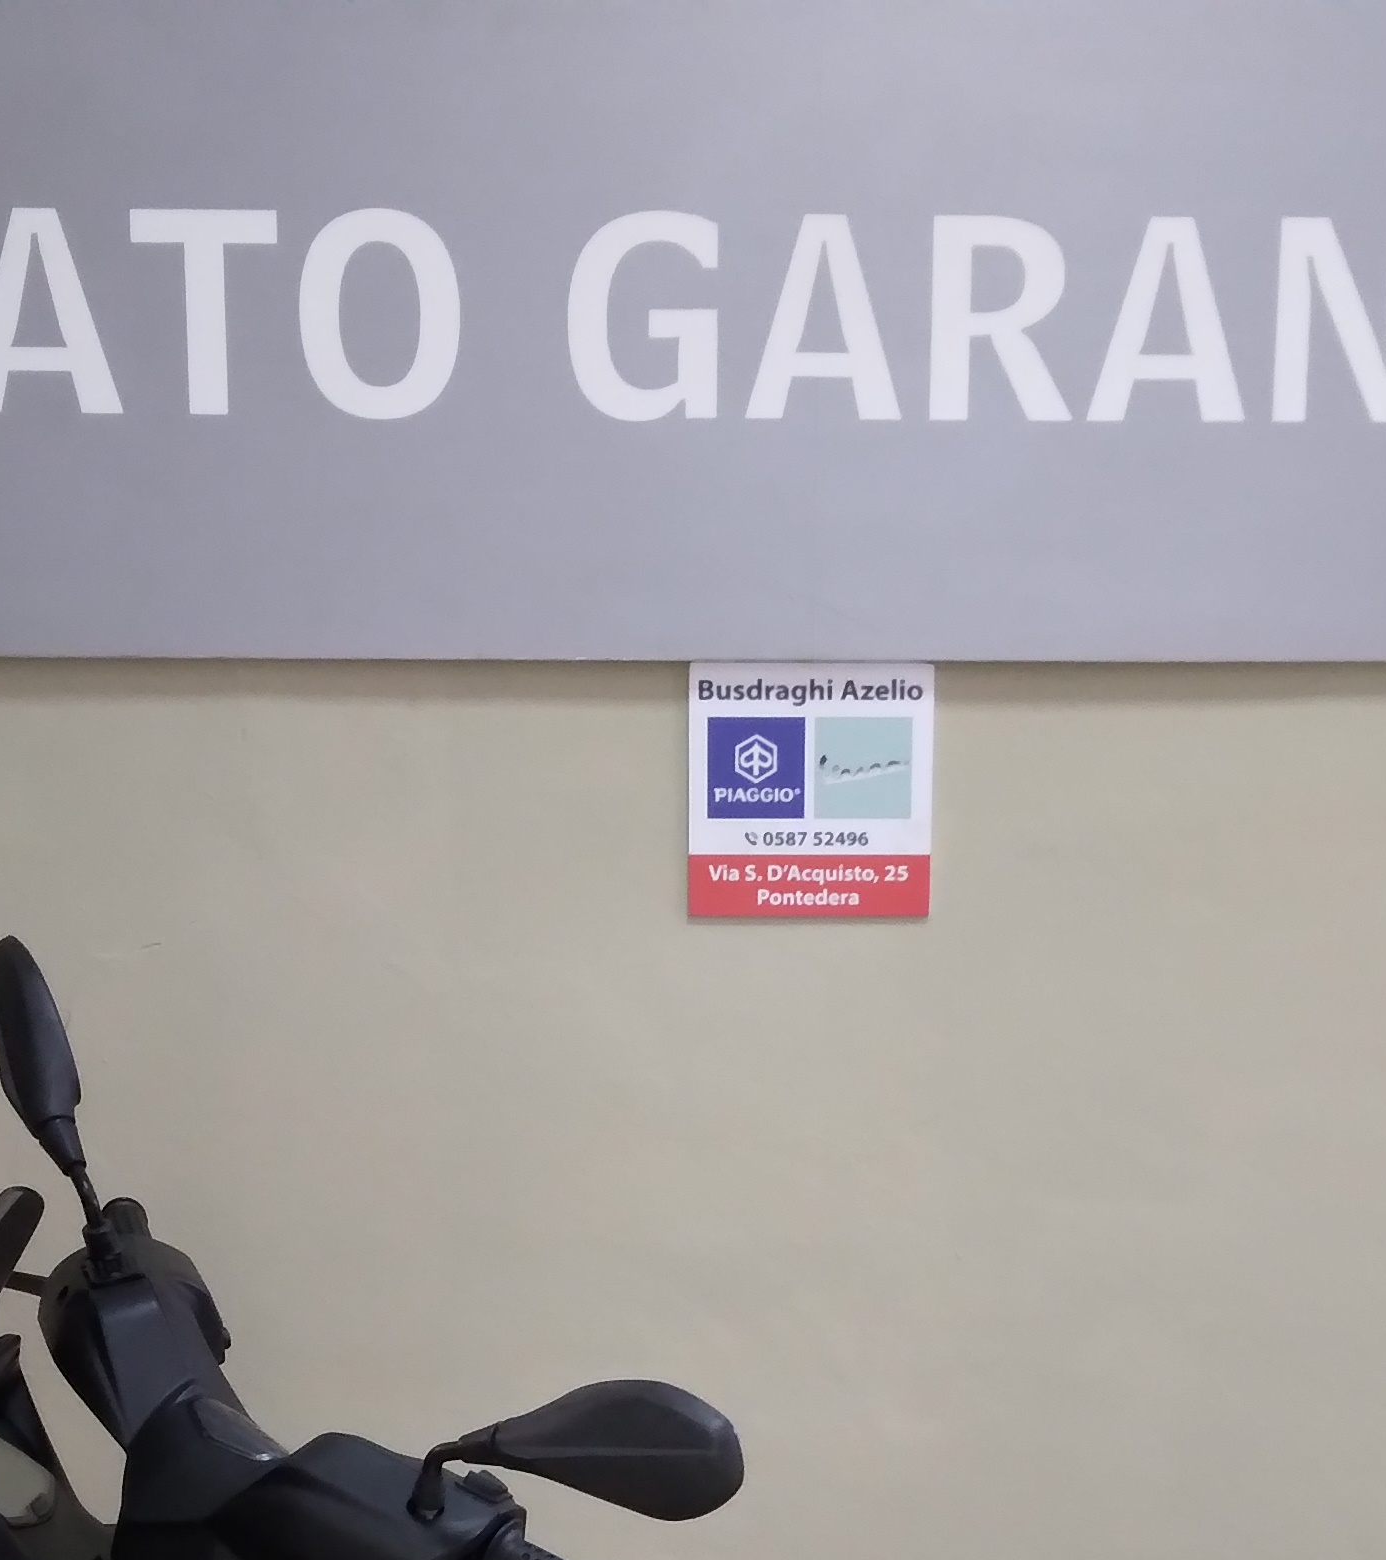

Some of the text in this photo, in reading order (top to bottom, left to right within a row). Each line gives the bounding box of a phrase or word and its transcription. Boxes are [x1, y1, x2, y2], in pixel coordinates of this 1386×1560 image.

[697, 678, 924, 706] Busdraghi Azelio
[763, 831, 869, 847] 0587 52496
[708, 864, 909, 885] Via S. D'Acquisto, 25
[756, 888, 860, 906] Pontedera
